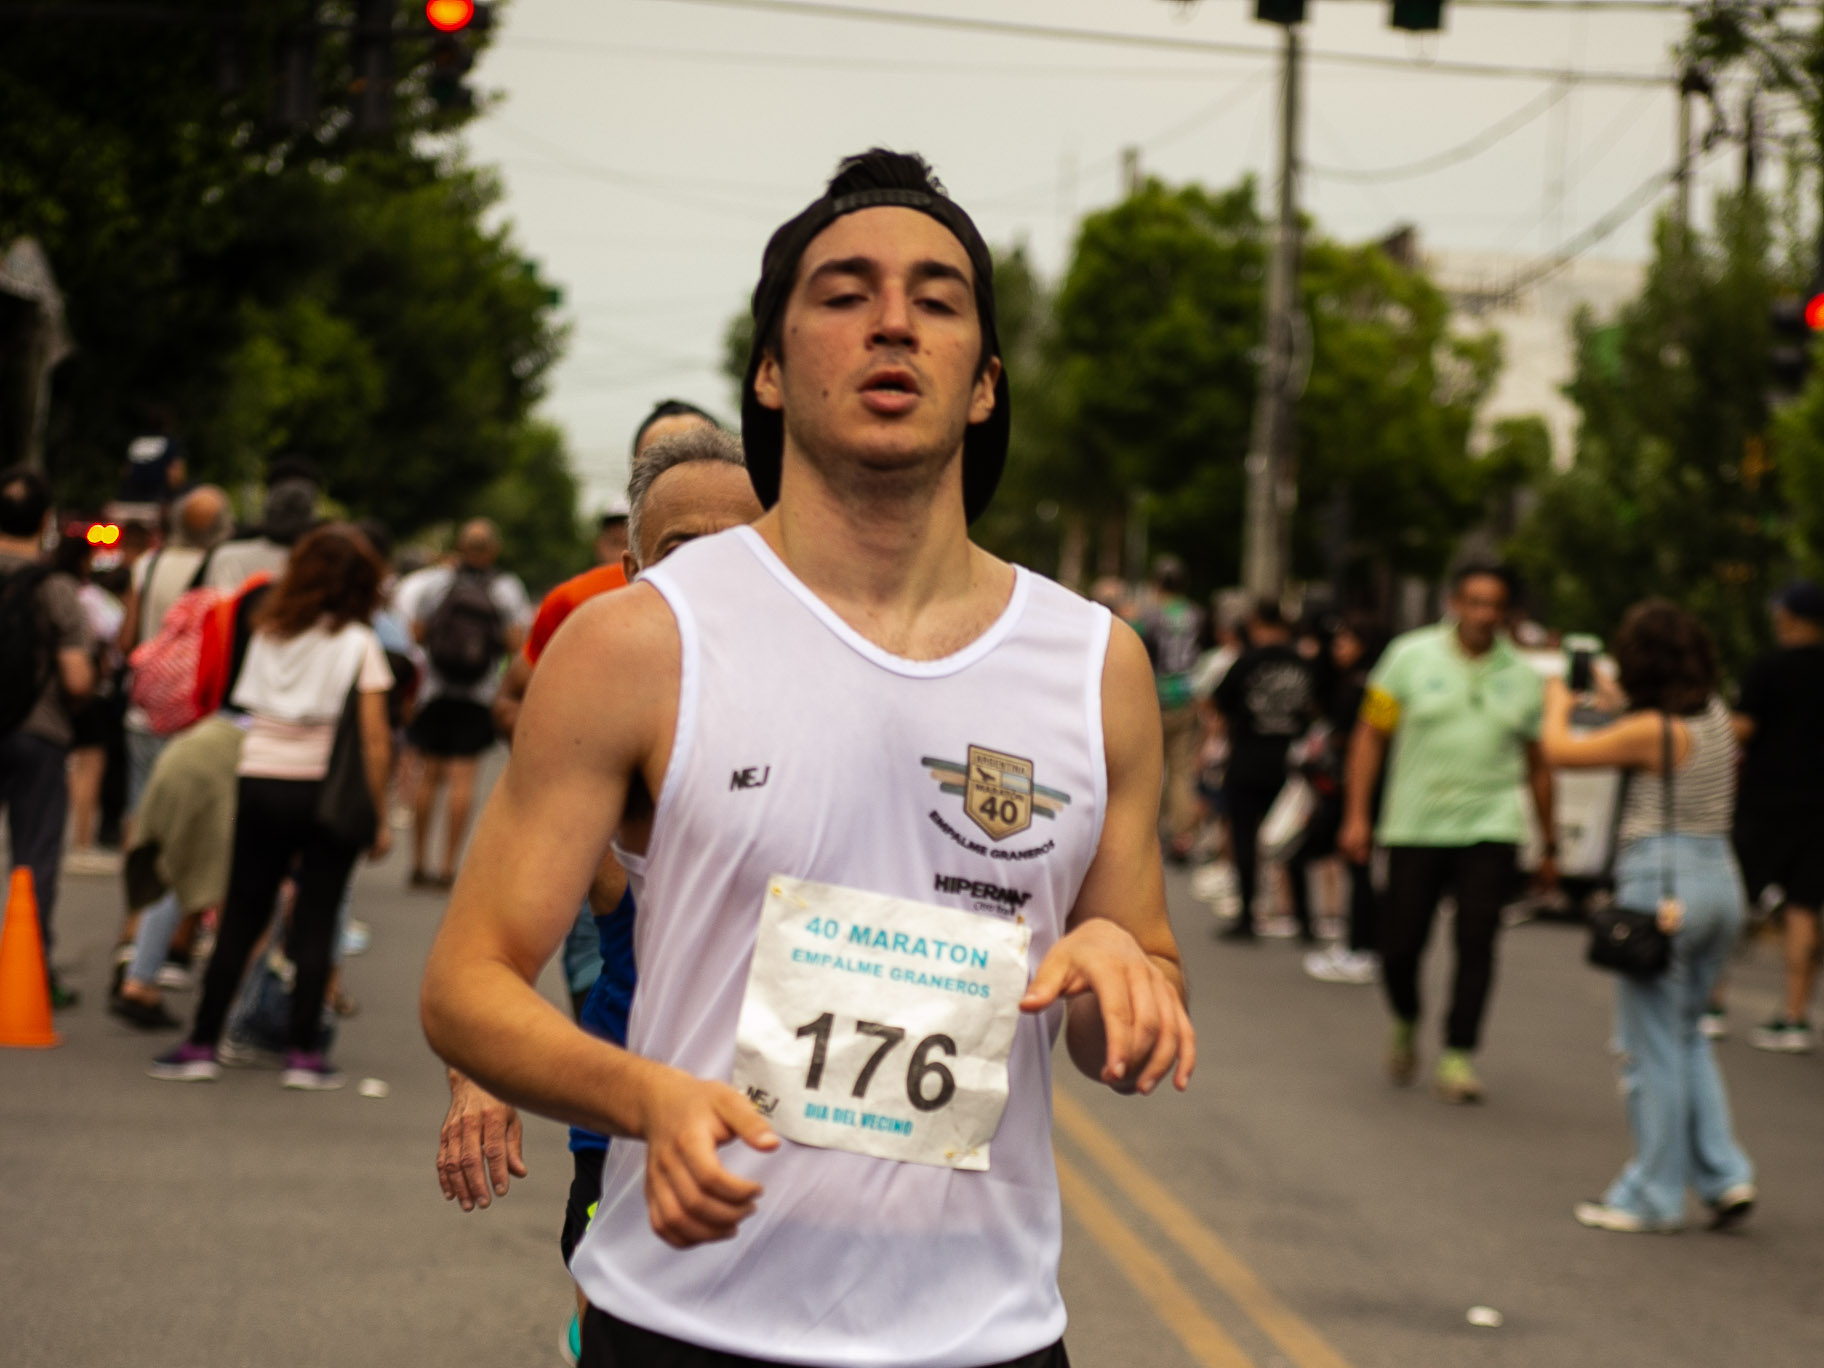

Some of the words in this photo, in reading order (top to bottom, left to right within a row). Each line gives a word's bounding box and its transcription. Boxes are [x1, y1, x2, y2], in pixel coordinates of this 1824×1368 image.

[729, 764, 771, 792] NEJ
[929, 810, 987, 857] EMPALME
[980, 796, 1018, 825] 40
[806, 916, 839, 940] 40
[850, 924, 989, 969] MARATON
[792, 947, 883, 979] EMPALME
[890, 967, 991, 999] GRANEROS
[796, 1012, 958, 1113] 176
[804, 1103, 828, 1121] DIA
[832, 1108, 856, 1127] DEL
[861, 1112, 913, 1137] VECINO
